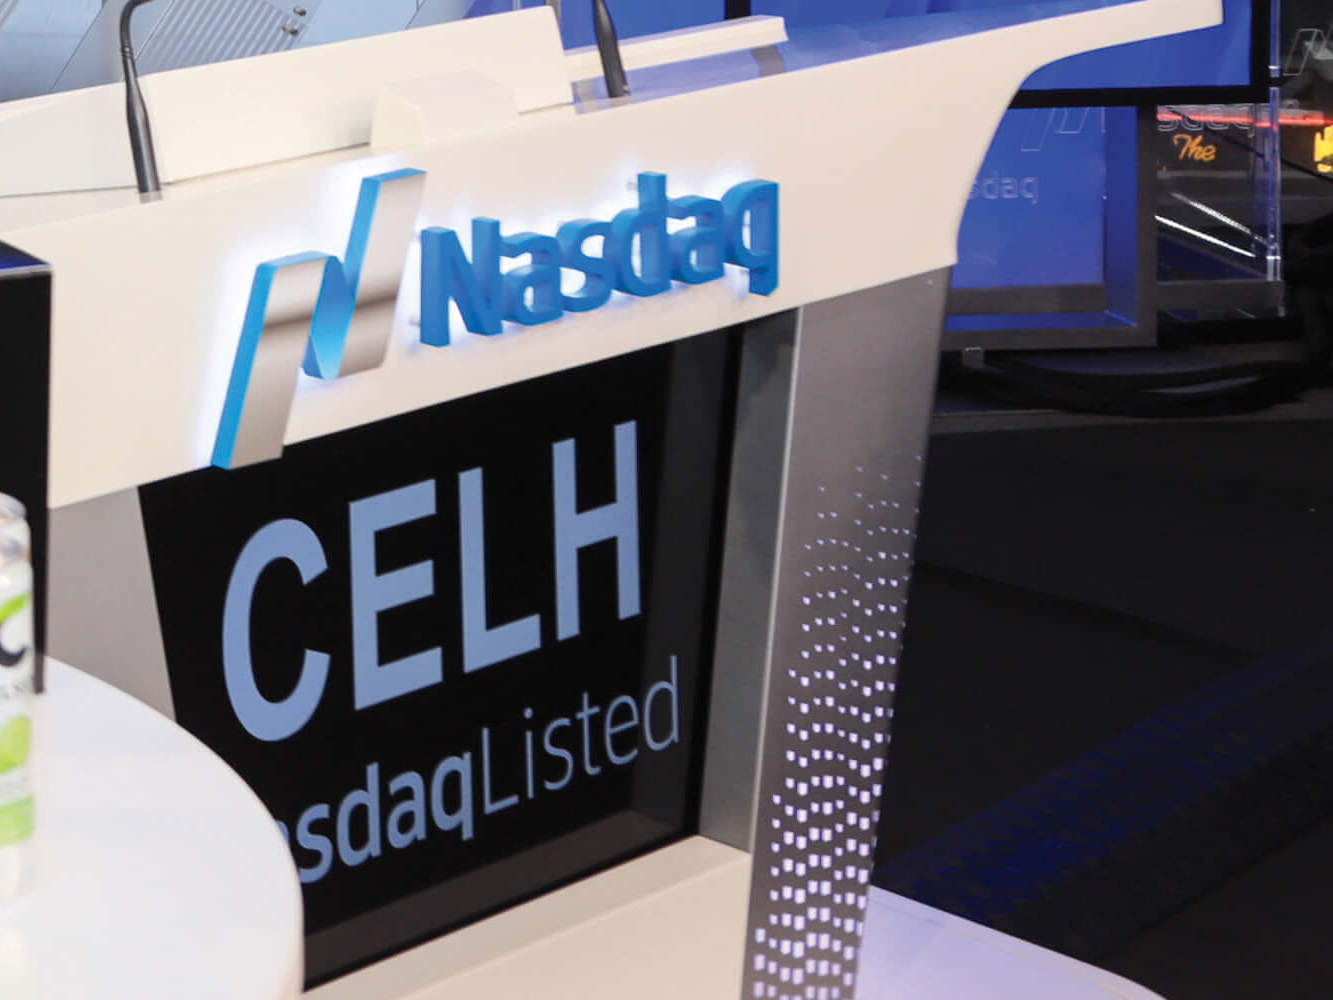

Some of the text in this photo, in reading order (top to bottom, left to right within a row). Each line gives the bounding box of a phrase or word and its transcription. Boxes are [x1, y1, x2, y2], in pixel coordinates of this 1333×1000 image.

[1172, 133, 1217, 162] The
[419, 171, 780, 347] Nasdaq
[221, 419, 643, 742] CELH
[279, 655, 682, 884] sdaqListed
